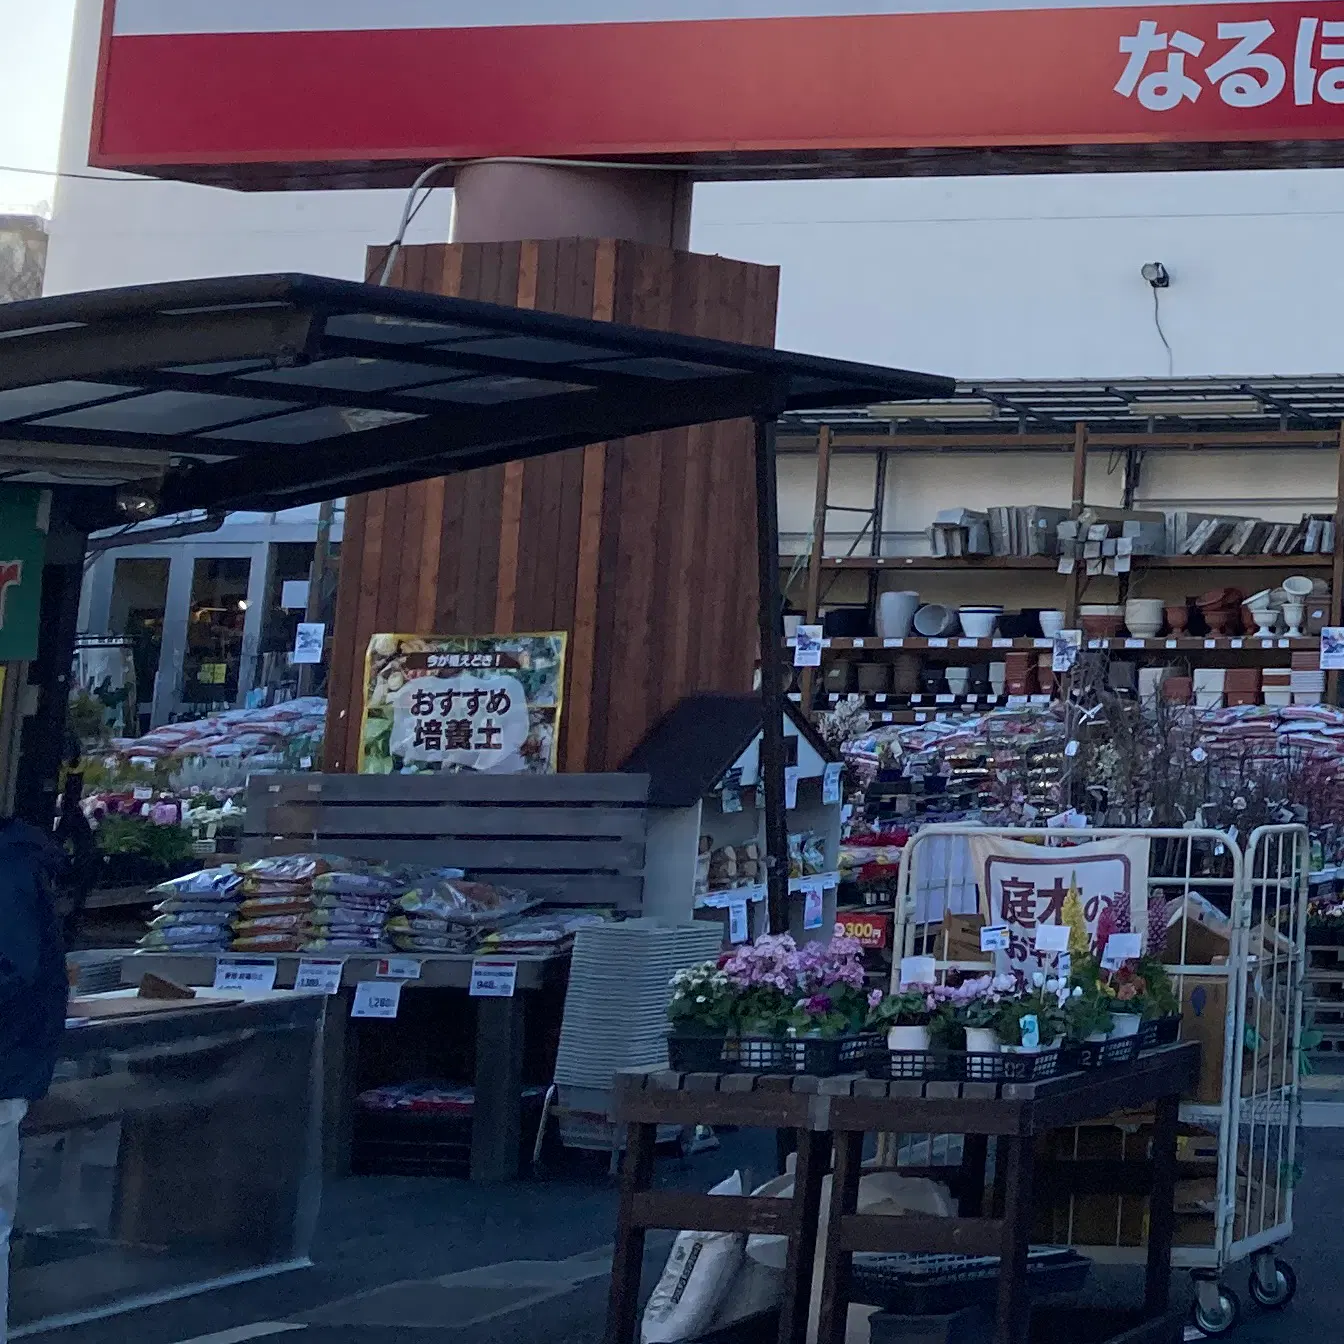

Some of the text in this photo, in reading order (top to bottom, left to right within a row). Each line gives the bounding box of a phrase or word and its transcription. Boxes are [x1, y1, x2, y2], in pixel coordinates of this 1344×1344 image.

[410, 688, 511, 717] おすすめ
[413, 718, 503, 751] 培養土
